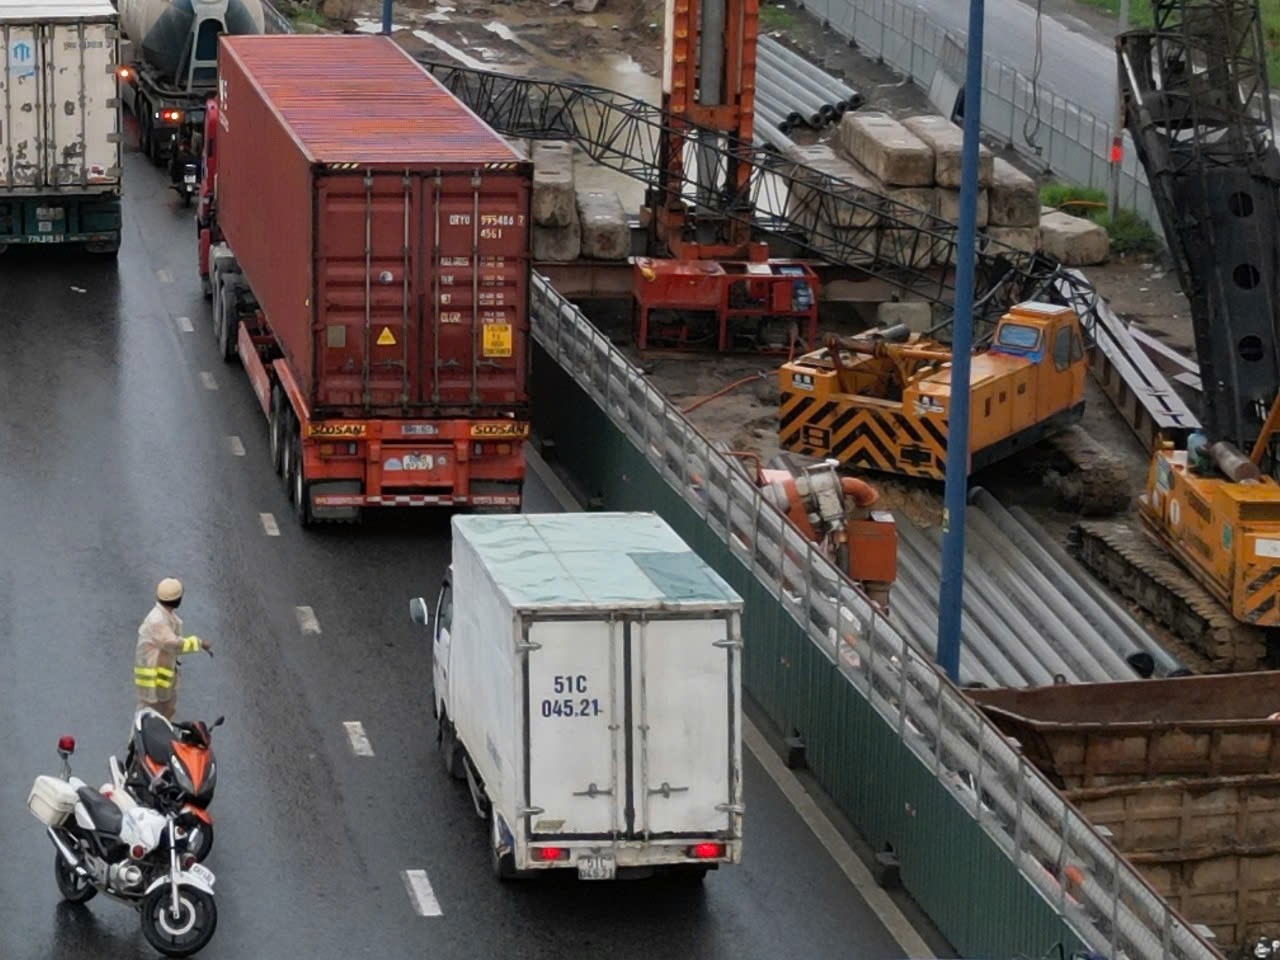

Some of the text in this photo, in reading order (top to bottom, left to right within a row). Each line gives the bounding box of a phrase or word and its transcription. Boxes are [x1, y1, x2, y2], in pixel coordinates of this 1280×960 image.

[311, 424, 362, 435] SOOSAN
[474, 424, 525, 435] SOOSAN
[554, 674, 587, 694] 51C
[541, 698, 599, 718] 045.21
